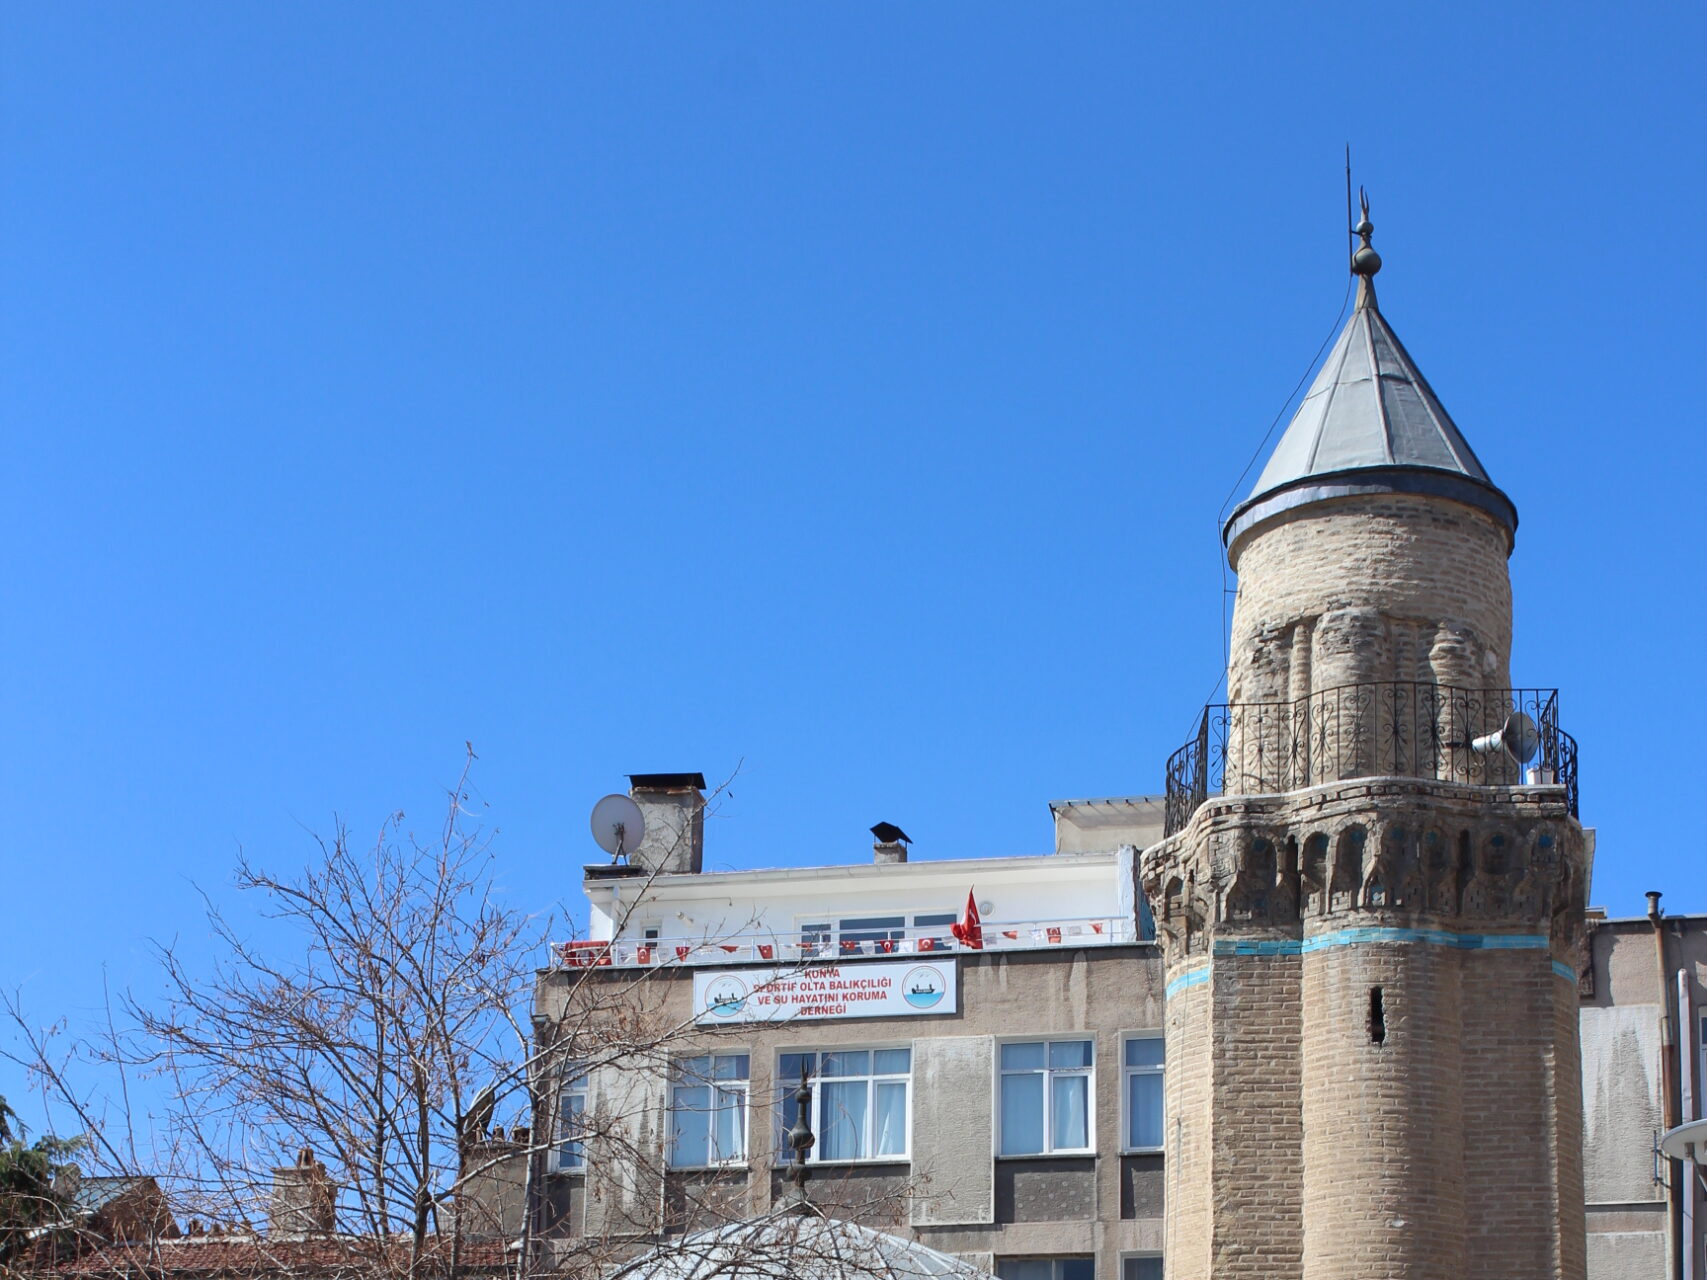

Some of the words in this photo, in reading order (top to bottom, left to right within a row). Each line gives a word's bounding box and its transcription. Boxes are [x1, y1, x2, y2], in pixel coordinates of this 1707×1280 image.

[804, 968, 840, 979] KONYA
[753, 981, 797, 993] SPORTİF
[799, 981, 826, 992] OLTA
[829, 977, 892, 991] BALIKÇILIĞI
[757, 995, 771, 1005] VE
[773, 994, 788, 1004] SU
[791, 993, 839, 1004] HAYATINI
[842, 990, 888, 1002] KORUMA
[800, 1003, 847, 1016] DERNEĞİ
